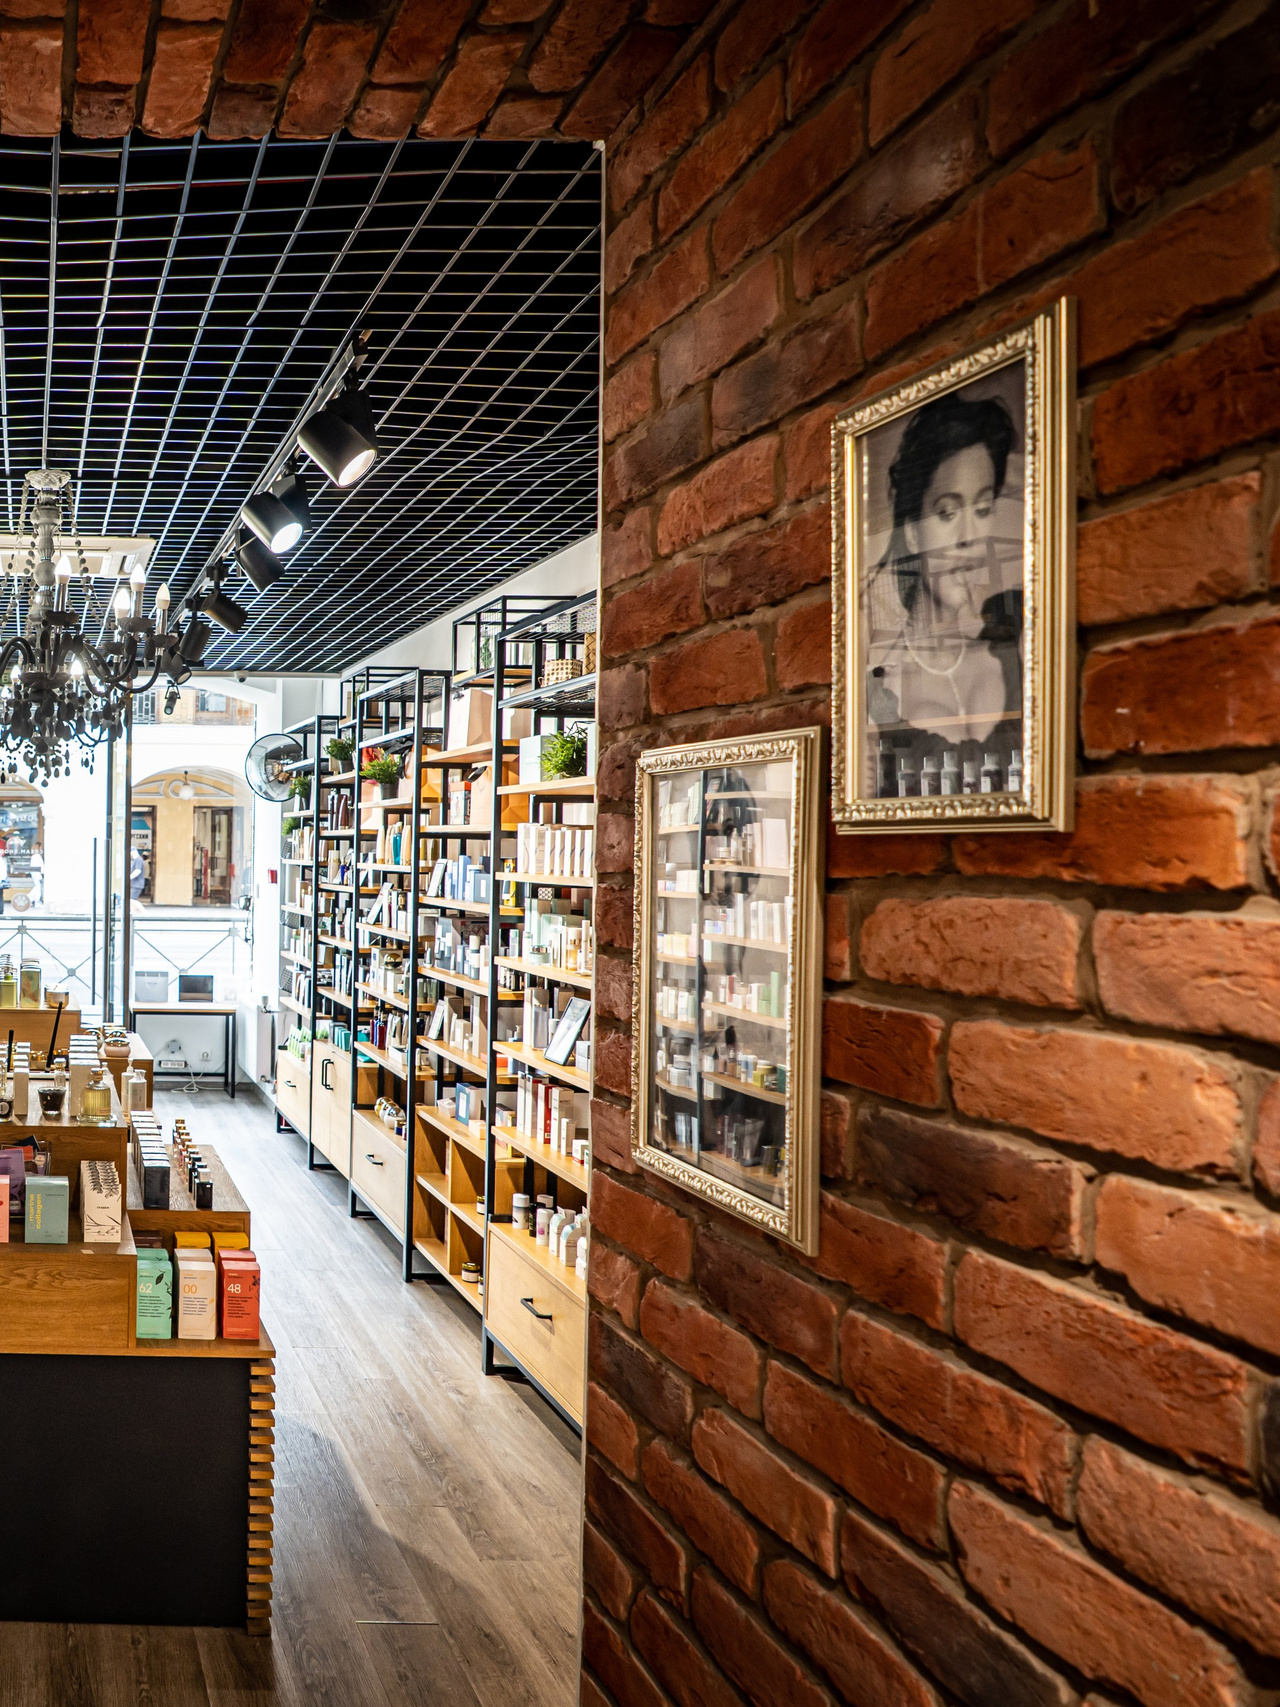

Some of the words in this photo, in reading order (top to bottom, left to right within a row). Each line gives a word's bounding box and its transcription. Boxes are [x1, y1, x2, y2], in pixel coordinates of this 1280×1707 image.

[138, 1282, 153, 1293] 62
[183, 1283, 198, 1294] 00
[227, 1283, 241, 1294] 48
